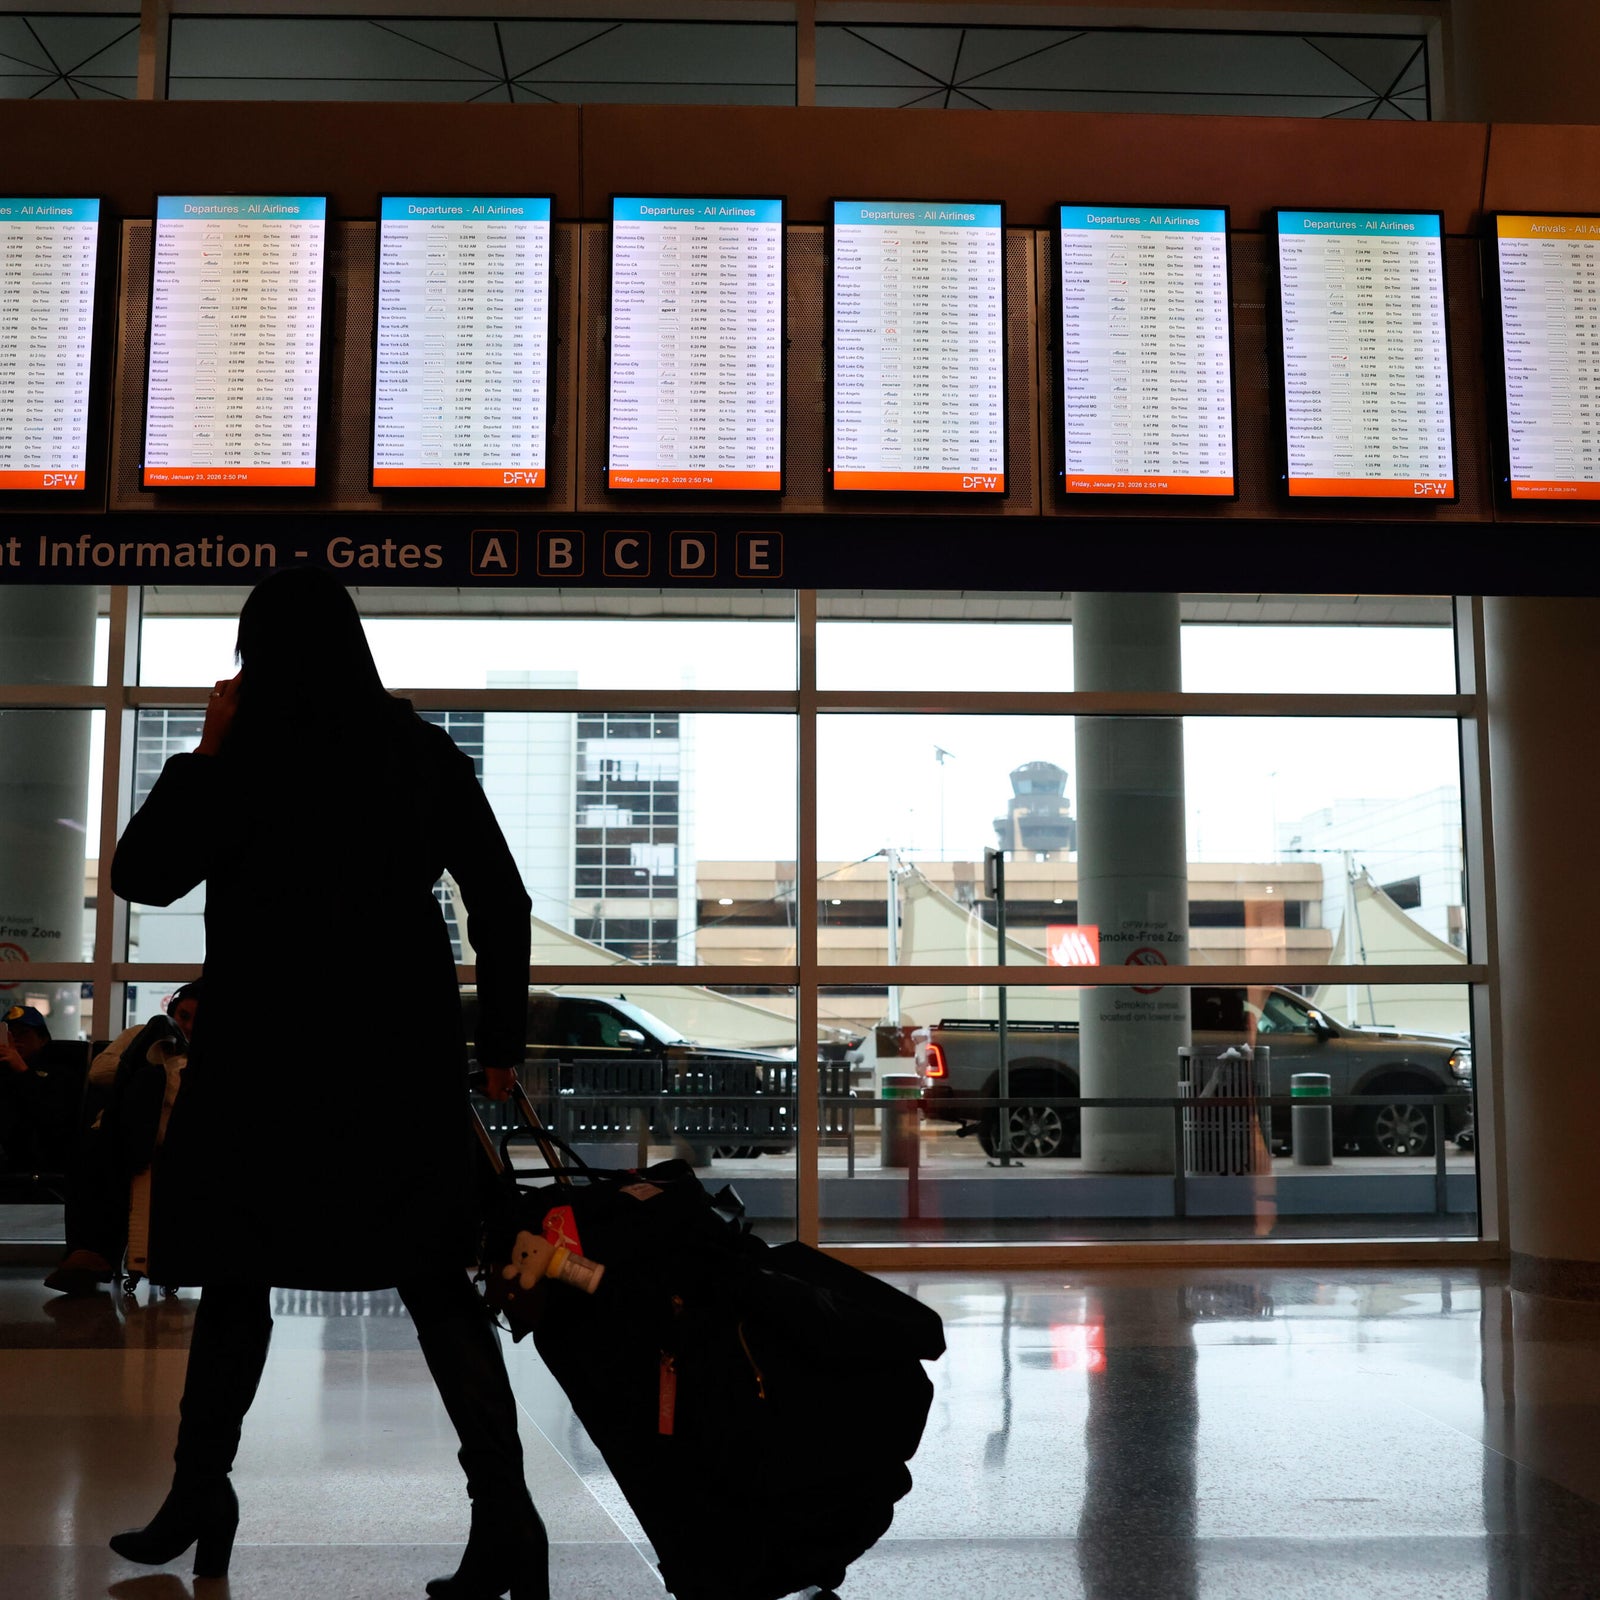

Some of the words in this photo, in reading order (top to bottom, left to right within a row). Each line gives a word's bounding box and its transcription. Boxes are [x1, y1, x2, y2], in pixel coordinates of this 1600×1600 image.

[36, 206, 72, 215] Airlines
[184, 205, 238, 214] Departures
[408, 205, 462, 215] Departures
[487, 206, 524, 214] Airlines
[640, 206, 695, 216] Departures
[704, 207, 716, 215] All
[719, 207, 755, 216] Airlines
[861, 210, 915, 220] Departures
[940, 212, 975, 221] Airlines
[1087, 214, 1140, 225] Departures
[1164, 217, 1200, 225] Airlines
[1304, 220, 1356, 230] Departures
[1381, 222, 1414, 230] Airlines
[1531, 224, 1565, 233] Arrivals
[44, 474, 77, 486] DFW
[504, 472, 538, 484] DFW
[963, 477, 997, 488] DFW
[1414, 483, 1447, 495] DFW
[39, 534, 276, 567] Information
[326, 537, 442, 569] Gates
[480, 538, 508, 568] A
[549, 538, 573, 569] B
[614, 539, 639, 570] C
[681, 539, 705, 570] D
[749, 540, 770, 570] E
[0, 925, 28, 937] Free
[1097, 931, 1164, 942] Smoke-Free
